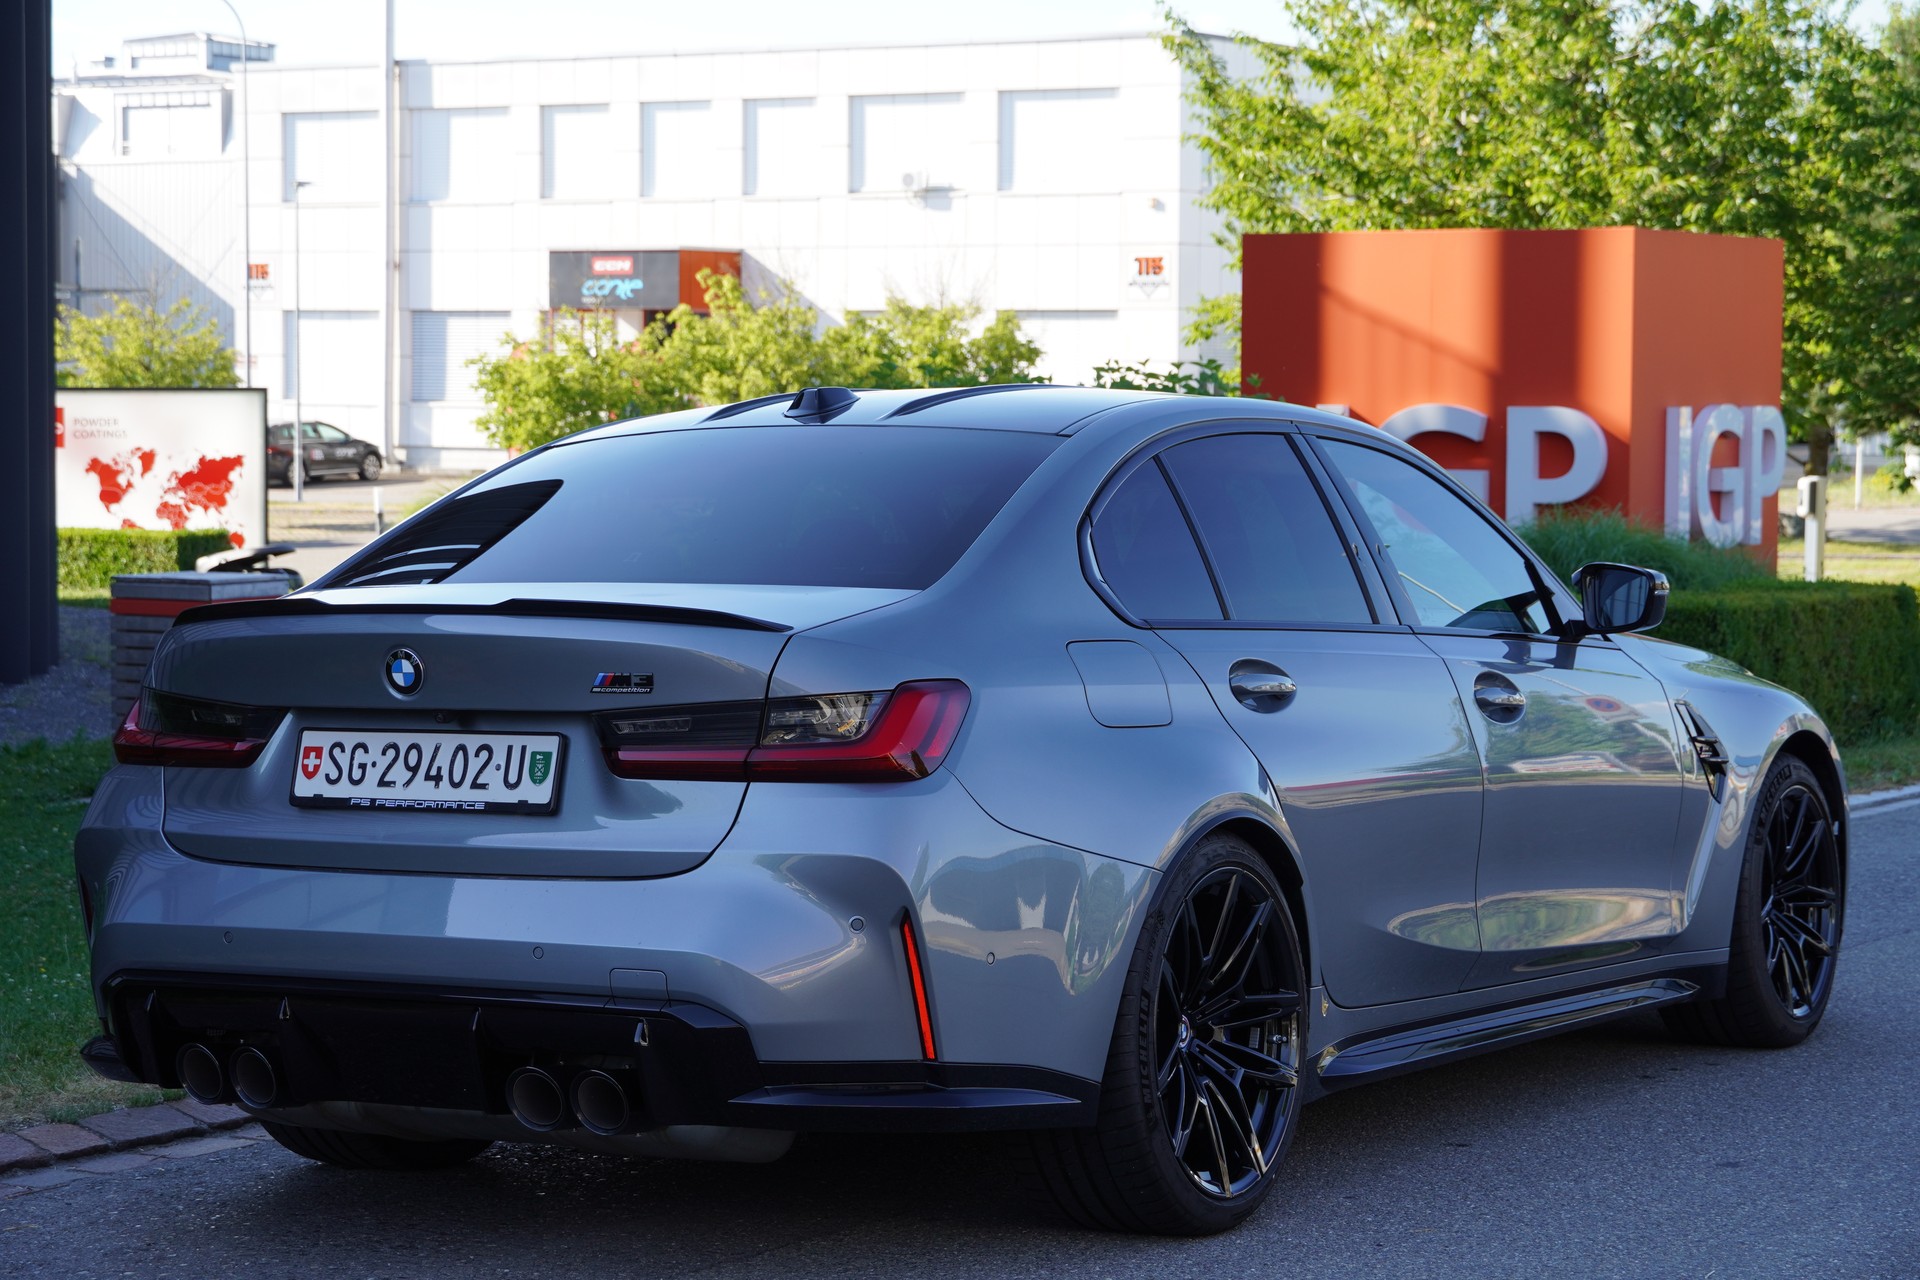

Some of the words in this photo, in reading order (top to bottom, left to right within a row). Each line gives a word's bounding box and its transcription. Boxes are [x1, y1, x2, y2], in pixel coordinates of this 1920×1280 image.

[73, 418, 119, 427] POWDER
[73, 430, 128, 439] COATINGS
[1315, 402, 1609, 527] GP
[1664, 403, 1787, 549] IGP
[607, 672, 654, 687] M3
[350, 798, 371, 807] PS
[375, 798, 486, 810] PERFORMANCE
[1138, 993, 1153, 1106] MICHELIN
